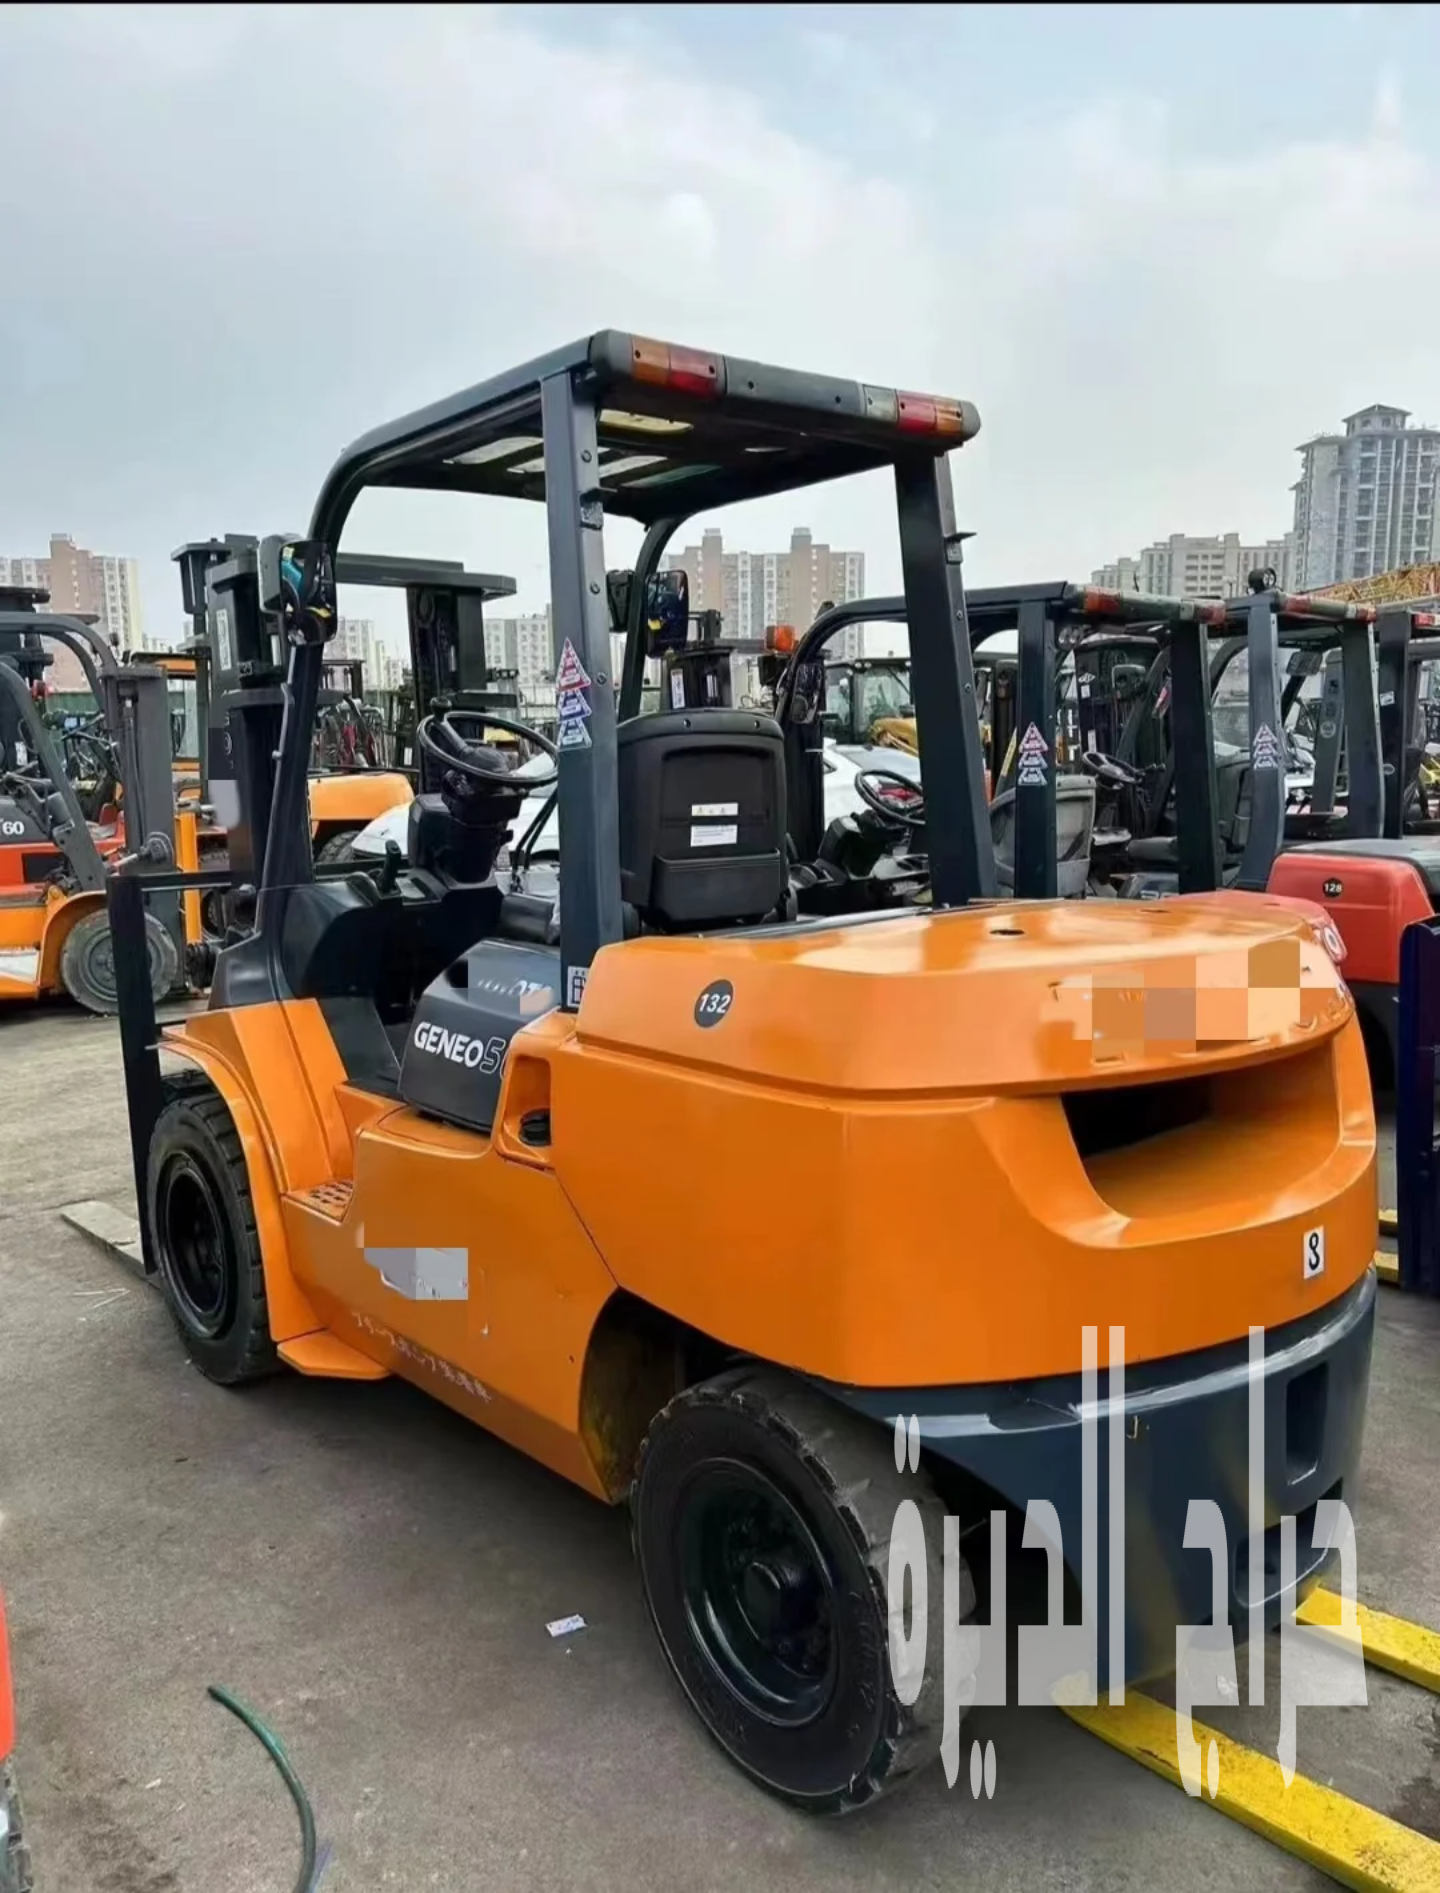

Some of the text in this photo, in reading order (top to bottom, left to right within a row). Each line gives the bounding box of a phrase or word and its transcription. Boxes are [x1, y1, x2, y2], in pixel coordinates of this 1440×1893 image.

[0, 818, 25, 836] 60
[699, 993, 731, 1014] 132
[414, 1021, 509, 1080] GENEO5
